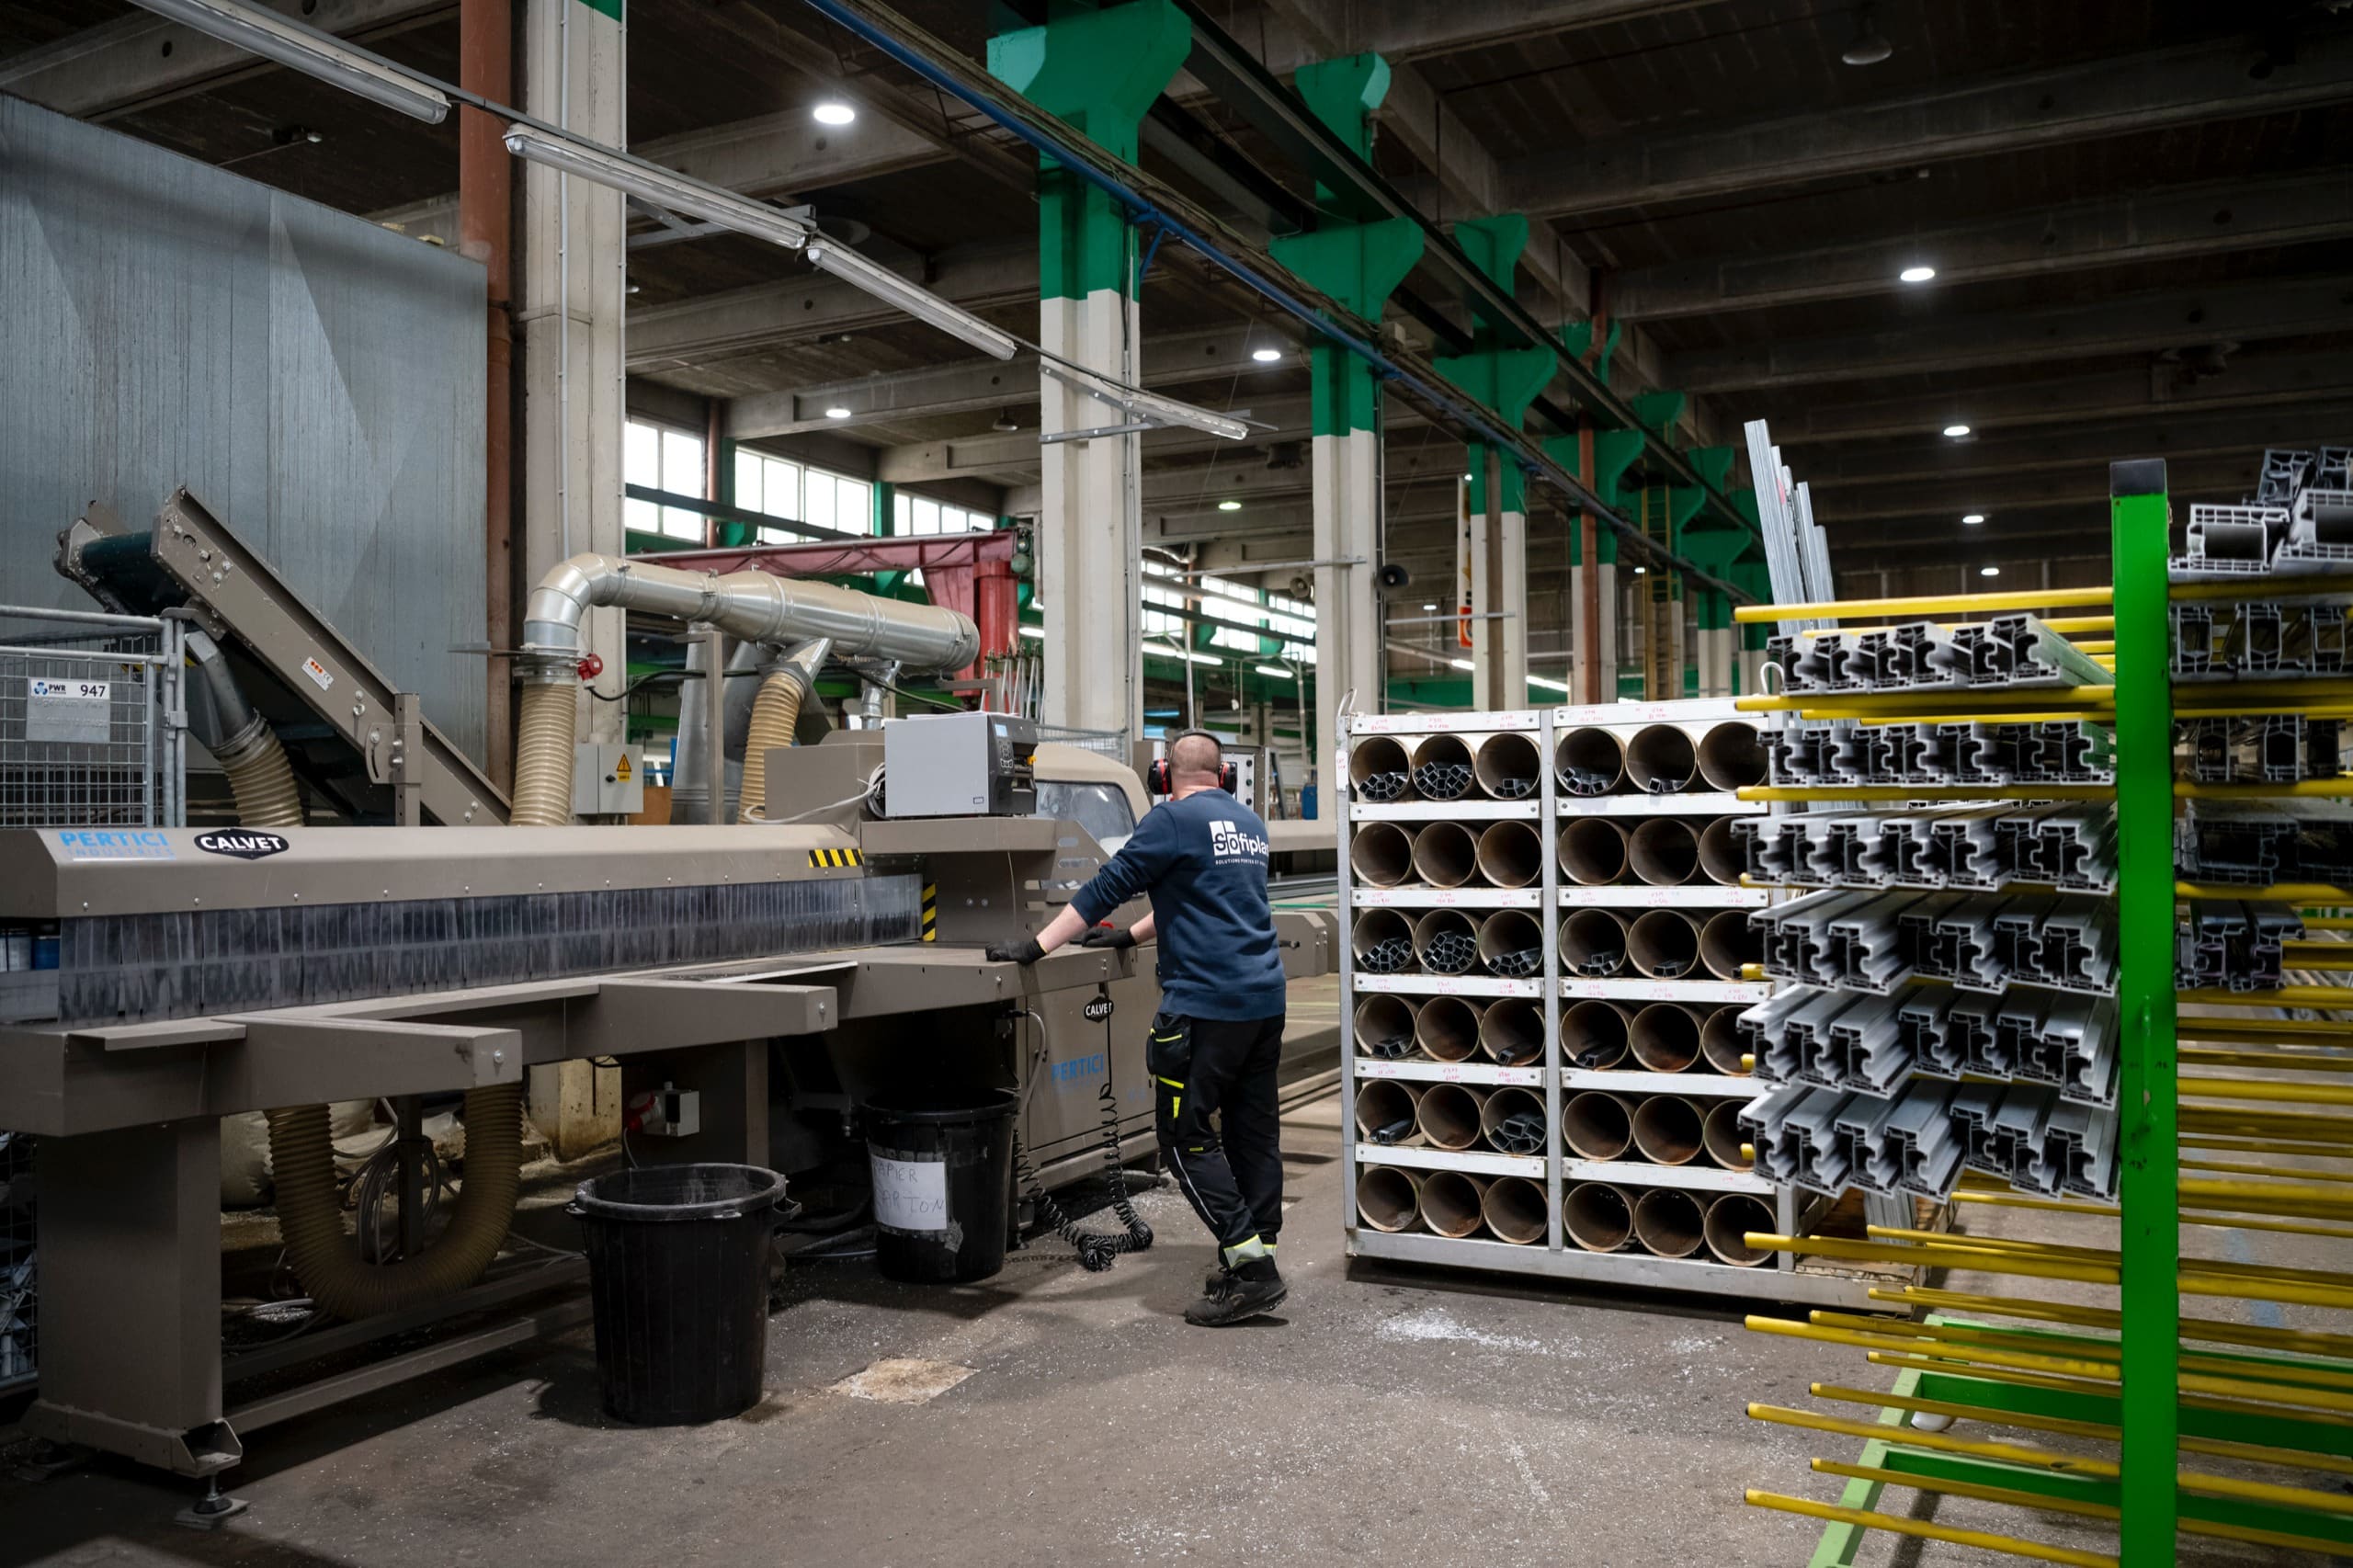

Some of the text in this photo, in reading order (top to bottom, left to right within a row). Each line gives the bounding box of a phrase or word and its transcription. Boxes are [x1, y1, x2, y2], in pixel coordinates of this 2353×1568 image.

[80, 685, 106, 697] 947
[59, 832, 168, 846] PERTICI
[200, 836, 281, 849] CALVET
[1051, 1052, 1104, 1083] PERTICI
